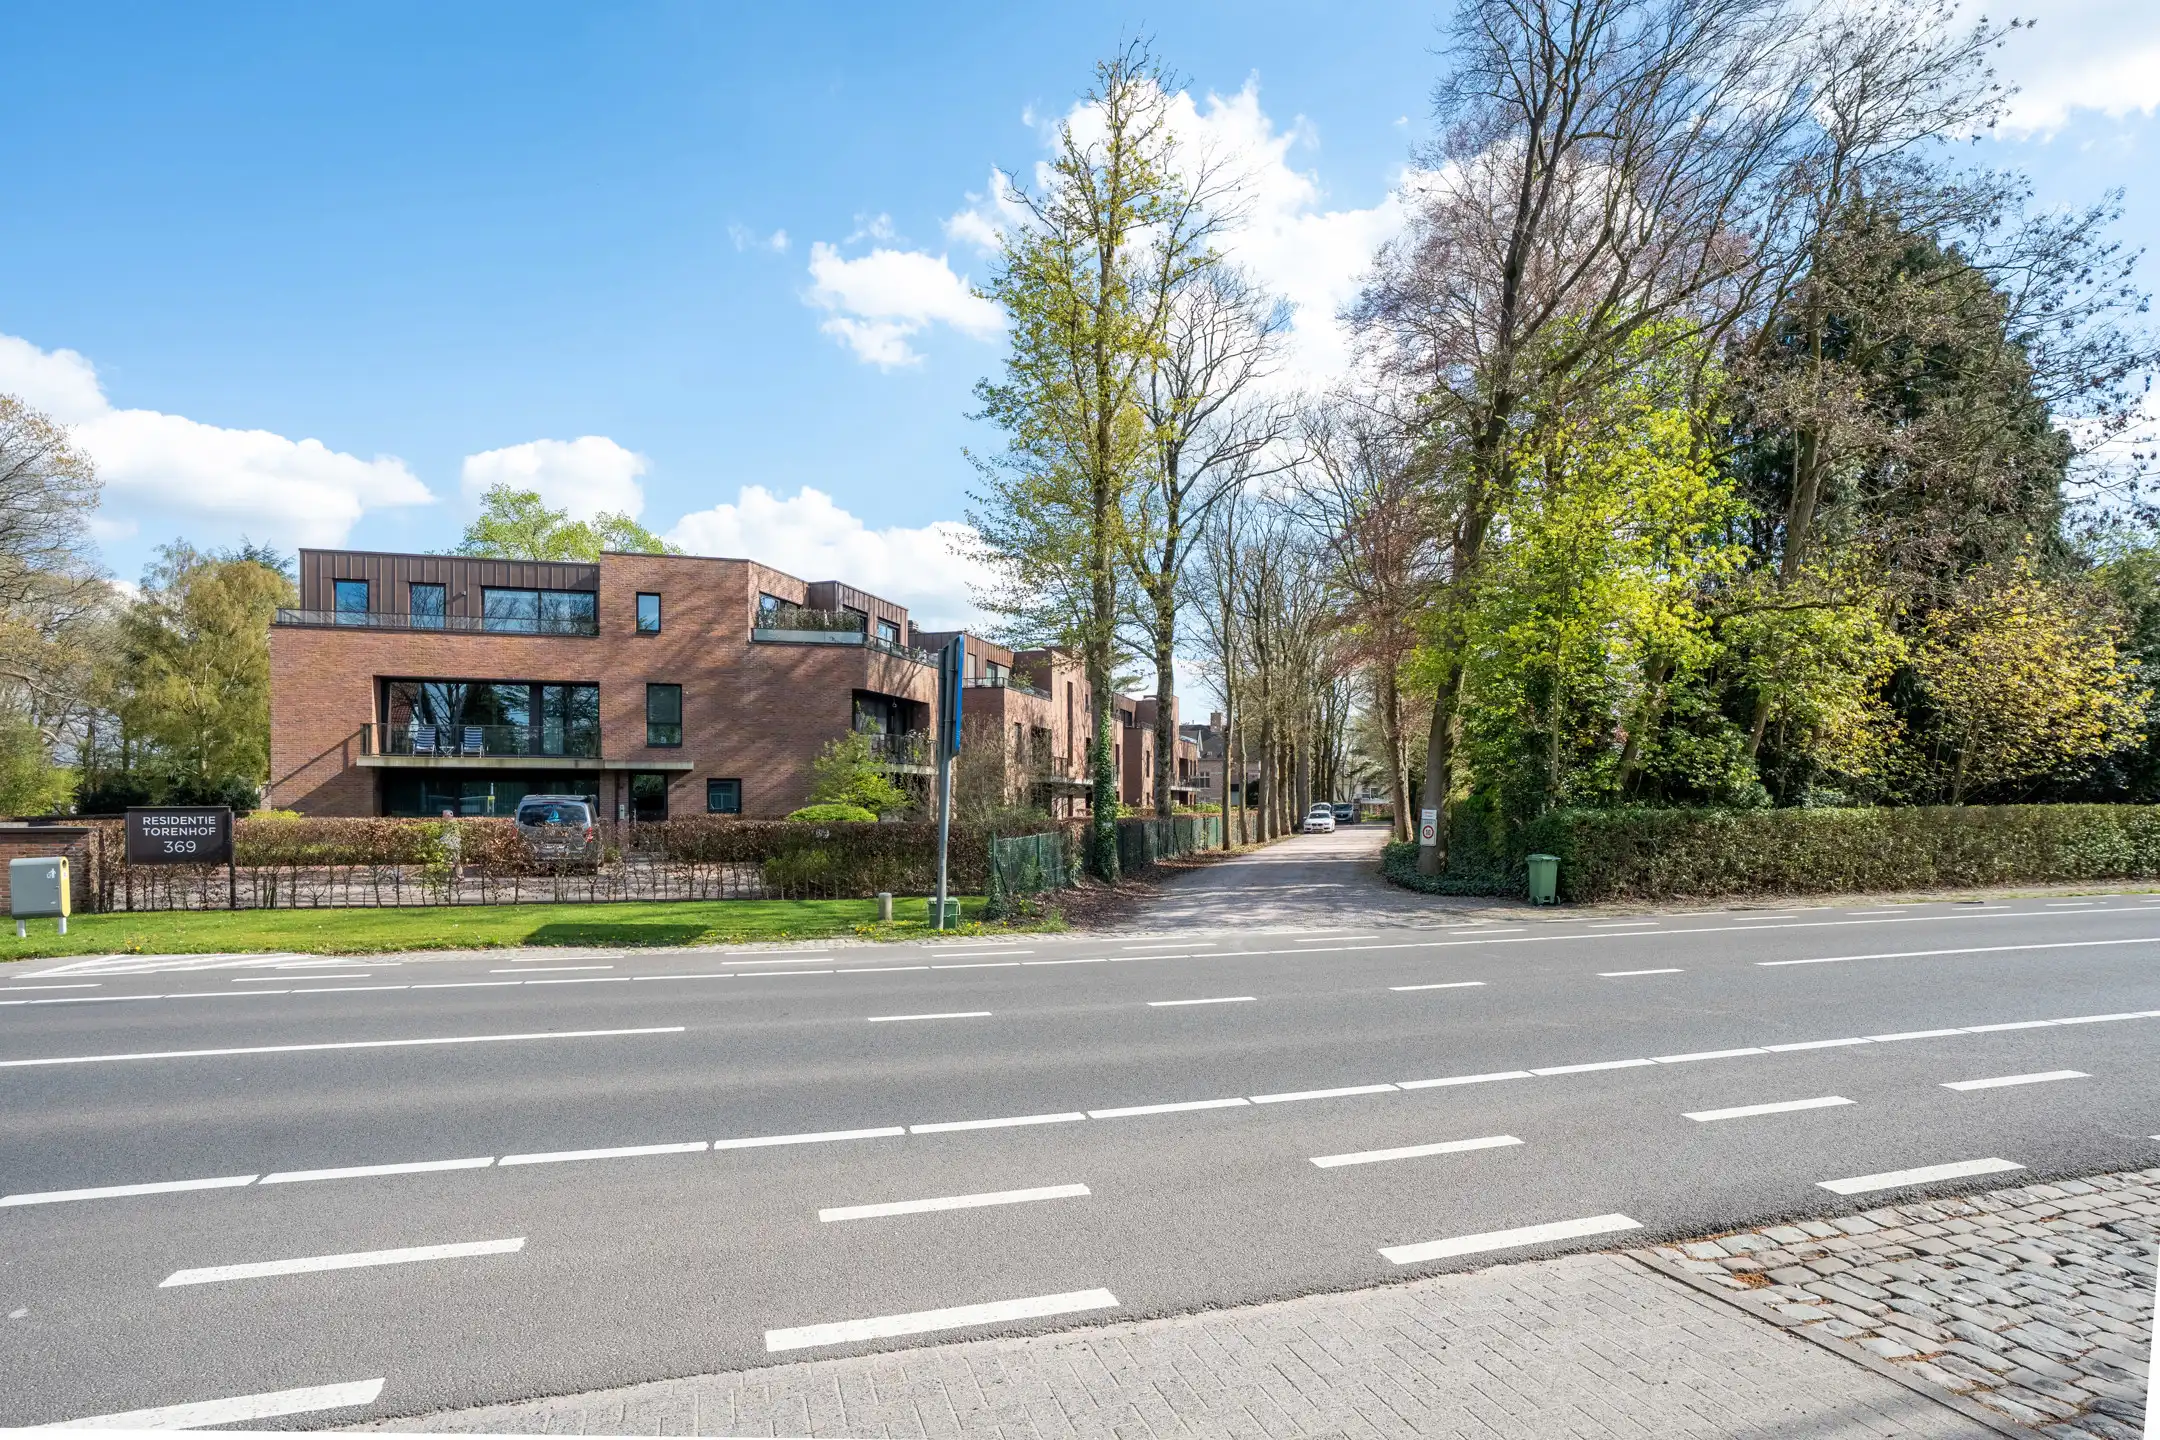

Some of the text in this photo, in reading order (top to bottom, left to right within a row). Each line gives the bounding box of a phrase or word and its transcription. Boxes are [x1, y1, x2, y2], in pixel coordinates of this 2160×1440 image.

[142, 816, 216, 825] RESIDENTIE
[142, 827, 216, 836] TORENHOF
[163, 840, 197, 853] 369
